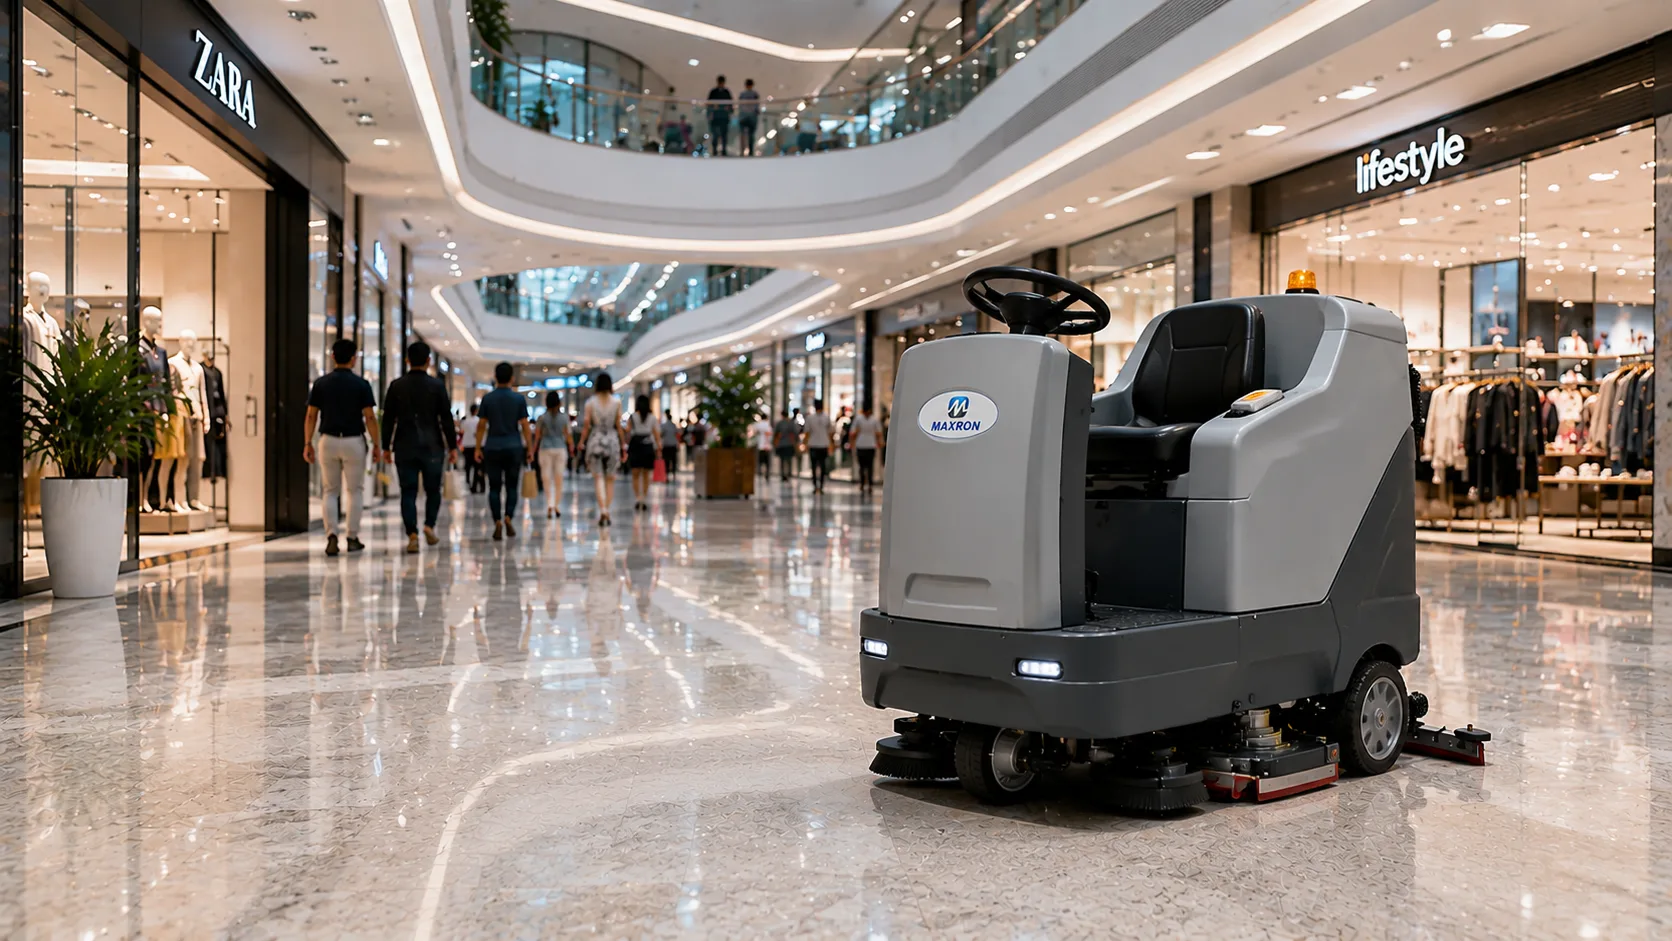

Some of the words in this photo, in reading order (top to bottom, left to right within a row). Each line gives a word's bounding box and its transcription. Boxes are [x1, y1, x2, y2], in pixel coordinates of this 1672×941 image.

[193, 29, 258, 129] ZARA
[1356, 127, 1466, 195] lifestyle
[930, 420, 981, 432] MAXRON
